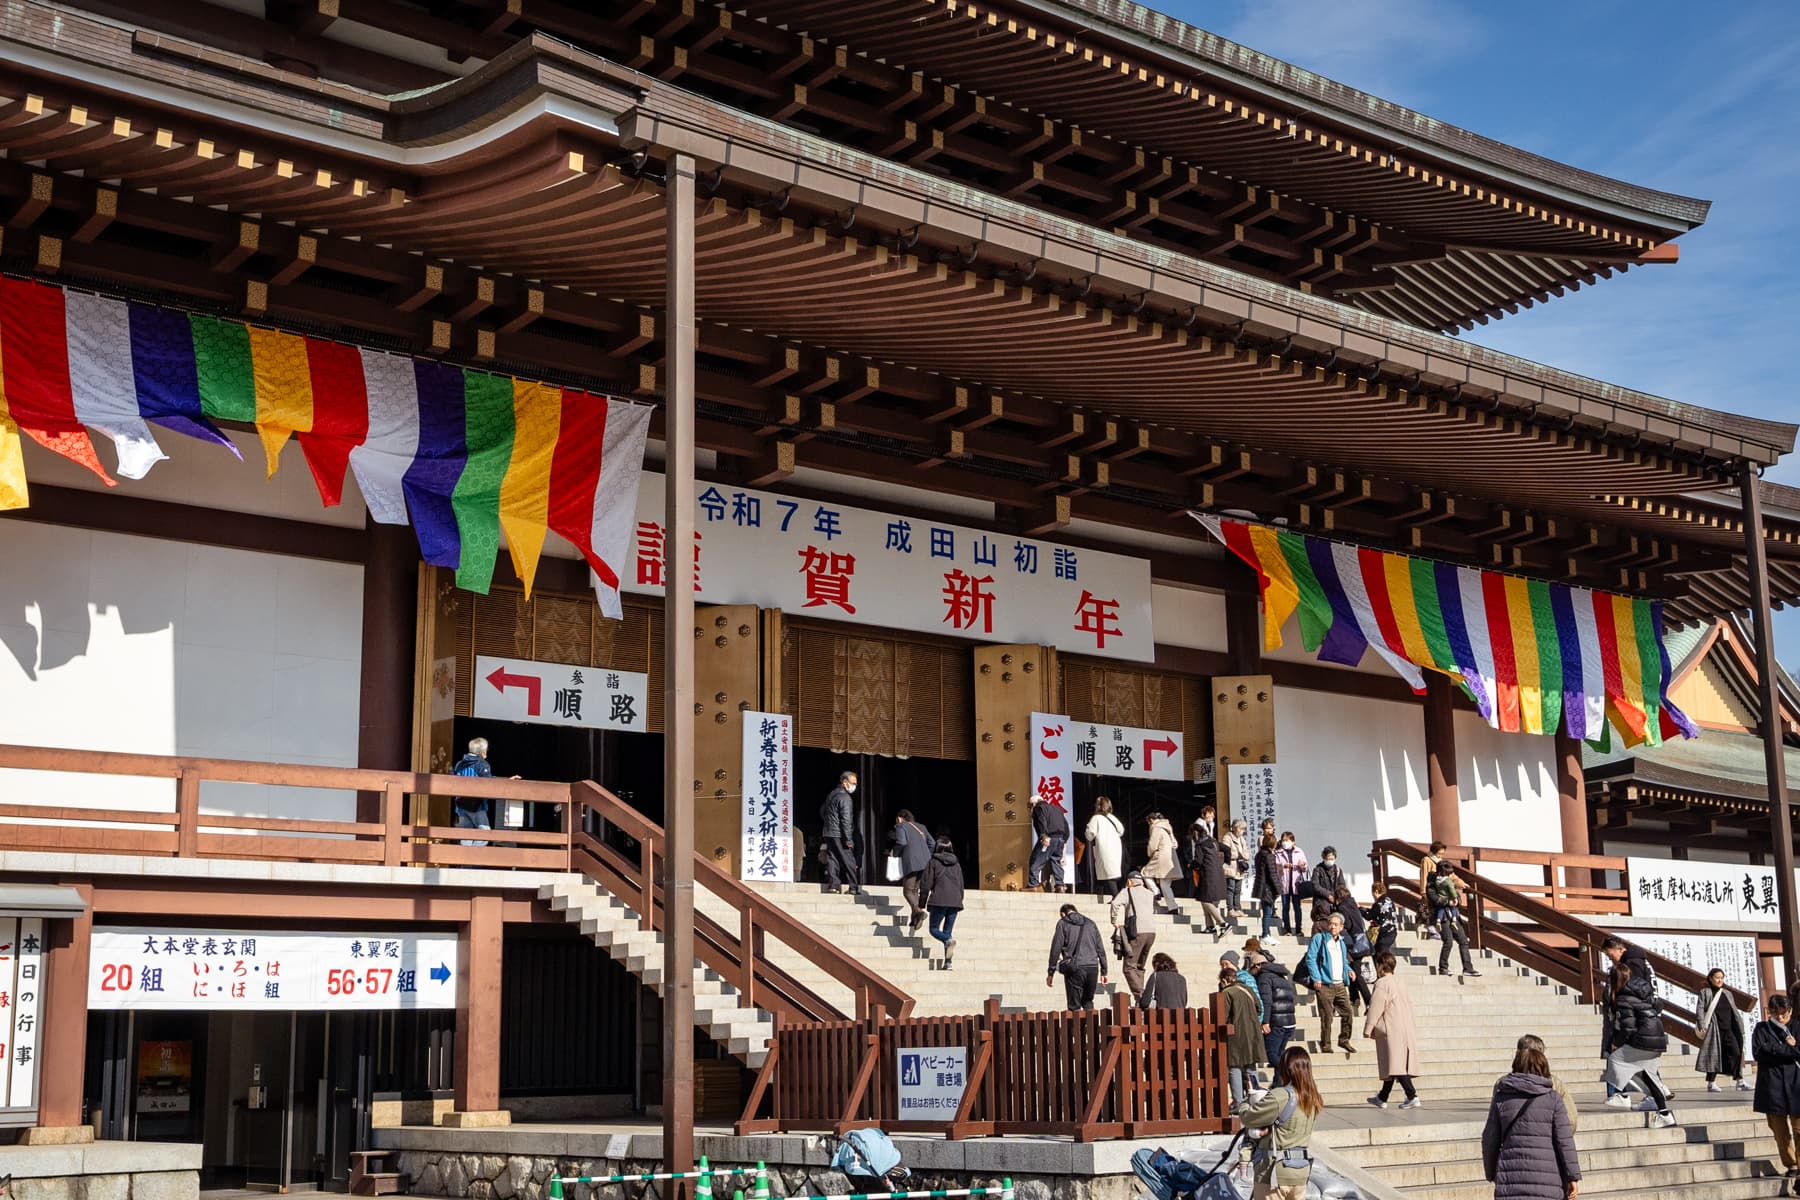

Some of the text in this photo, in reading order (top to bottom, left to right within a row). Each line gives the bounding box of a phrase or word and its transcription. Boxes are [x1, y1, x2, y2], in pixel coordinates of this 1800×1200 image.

[698, 487, 1078, 581] 令和7年 成田山初詣
[570, 669, 619, 690] 参詣
[553, 688, 638, 725] 順路
[1088, 724, 1123, 742] 参詣
[1076, 741, 1135, 771] 順路
[758, 718, 779, 877] 新春特別大祈祷会
[1638, 876, 1734, 905] 御護摩札お渡し所
[143, 936, 257, 957] 大本堂表玄関
[350, 940, 400, 959] 東翼殿
[15, 933, 39, 1067] 本日の行事
[921, 1055, 963, 1069] ベビーカー
[936, 1072, 962, 1087] 置き場
